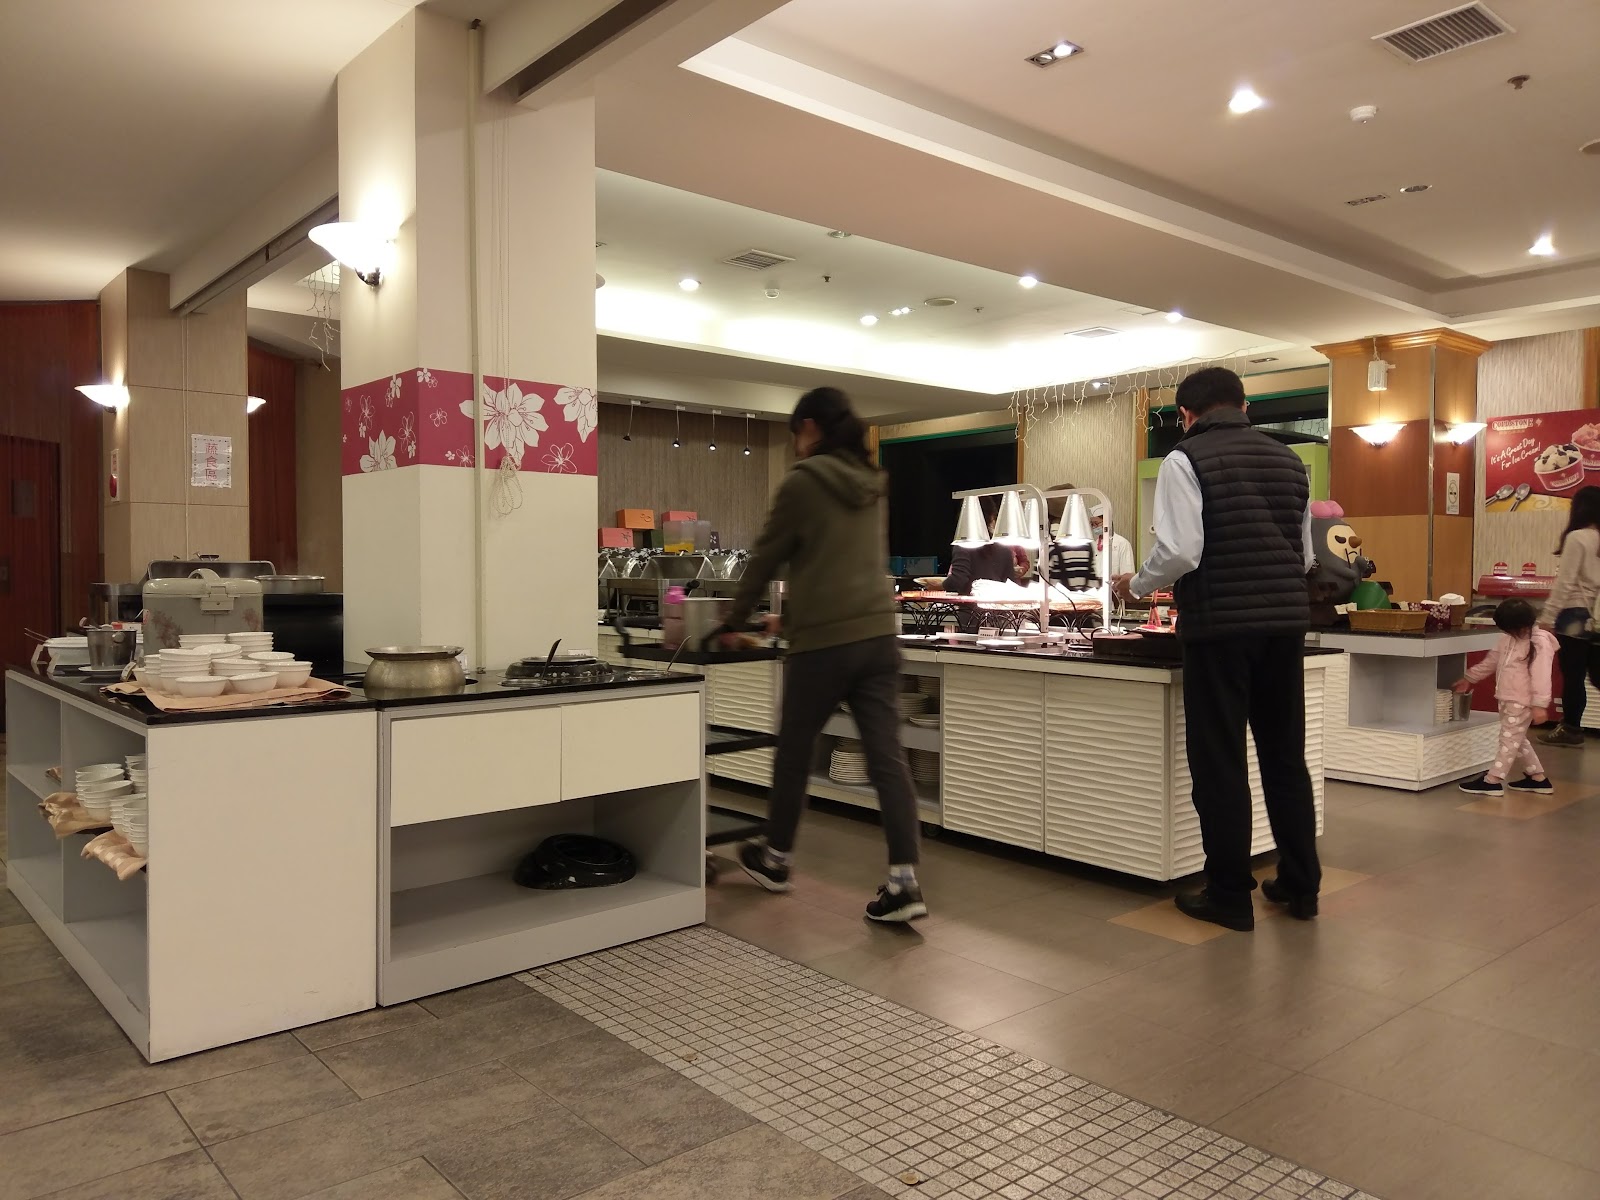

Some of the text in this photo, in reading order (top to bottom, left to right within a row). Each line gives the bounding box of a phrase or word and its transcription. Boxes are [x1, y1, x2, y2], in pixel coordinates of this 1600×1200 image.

[1501, 450, 1507, 460] A
[1507, 443, 1522, 457] Great
[1523, 438, 1535, 448] Day
[205, 442, 218, 481] 蔬食區
[1502, 460, 1511, 470] For
